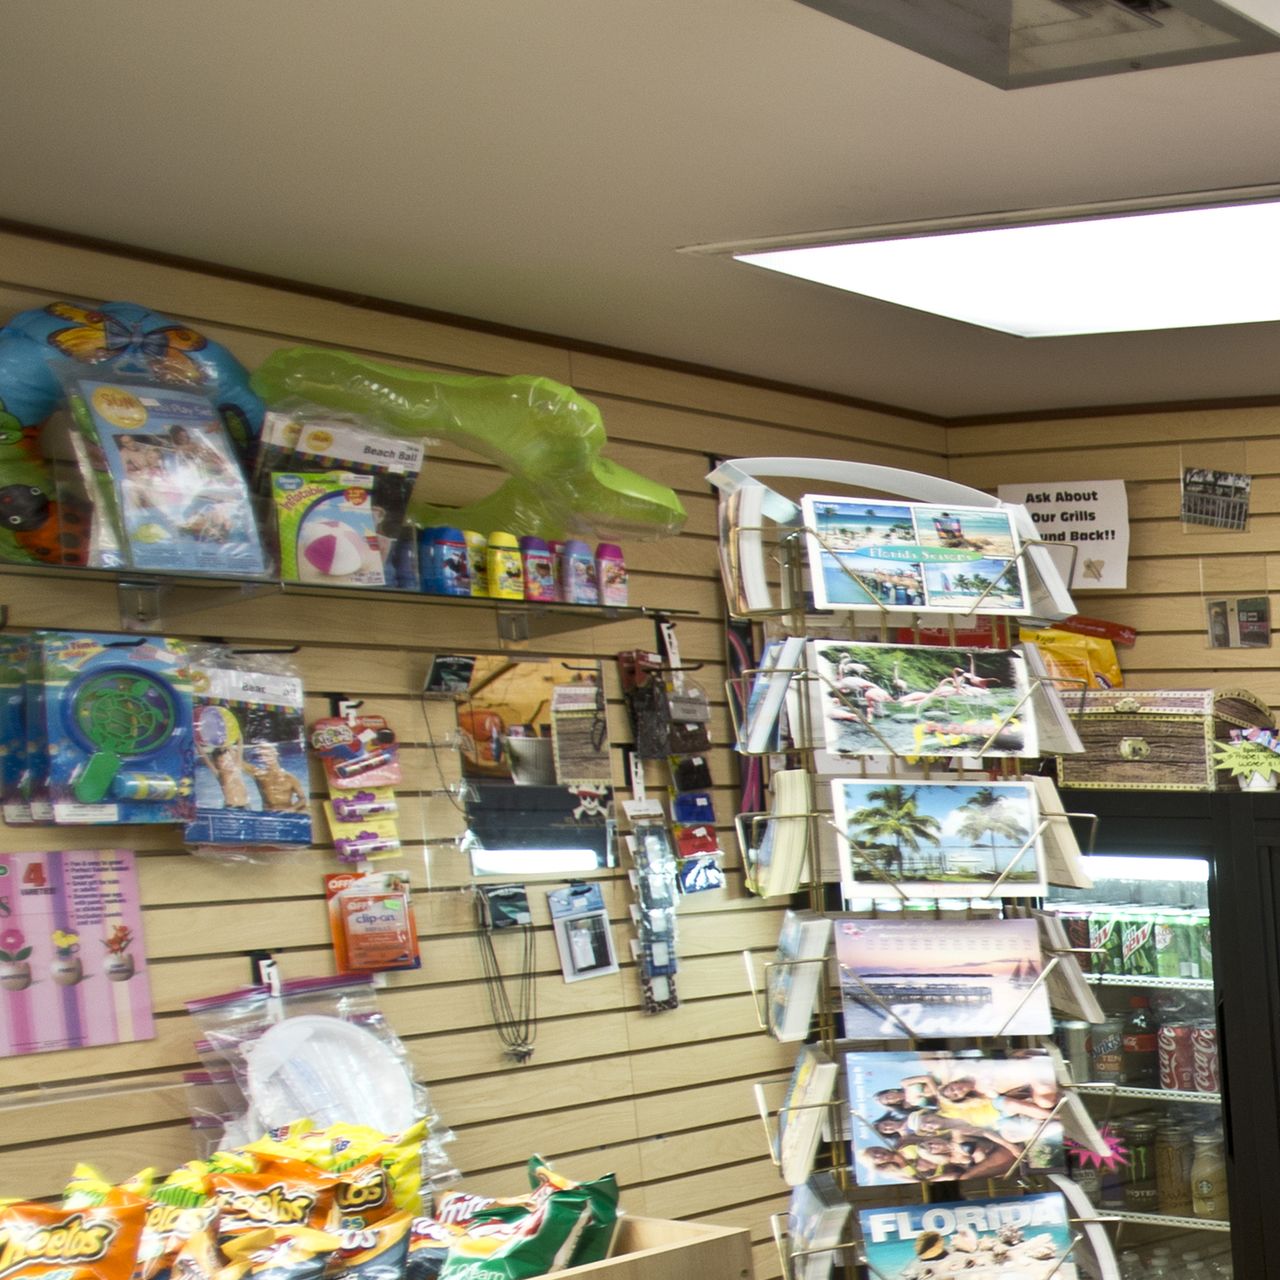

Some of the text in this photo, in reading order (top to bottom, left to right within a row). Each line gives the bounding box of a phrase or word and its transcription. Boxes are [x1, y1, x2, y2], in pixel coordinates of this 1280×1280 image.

[363, 445, 418, 463] Beach Ball
[1025, 491, 1098, 504] Ask About
[1031, 511, 1096, 523] Our Grills
[1041, 530, 1116, 542] und Back!!
[22, 862, 47, 888] 4
[355, 913, 396, 925] clip-on
[869, 1198, 1065, 1243] FLORIDA
[0, 1213, 109, 1271] heetos
